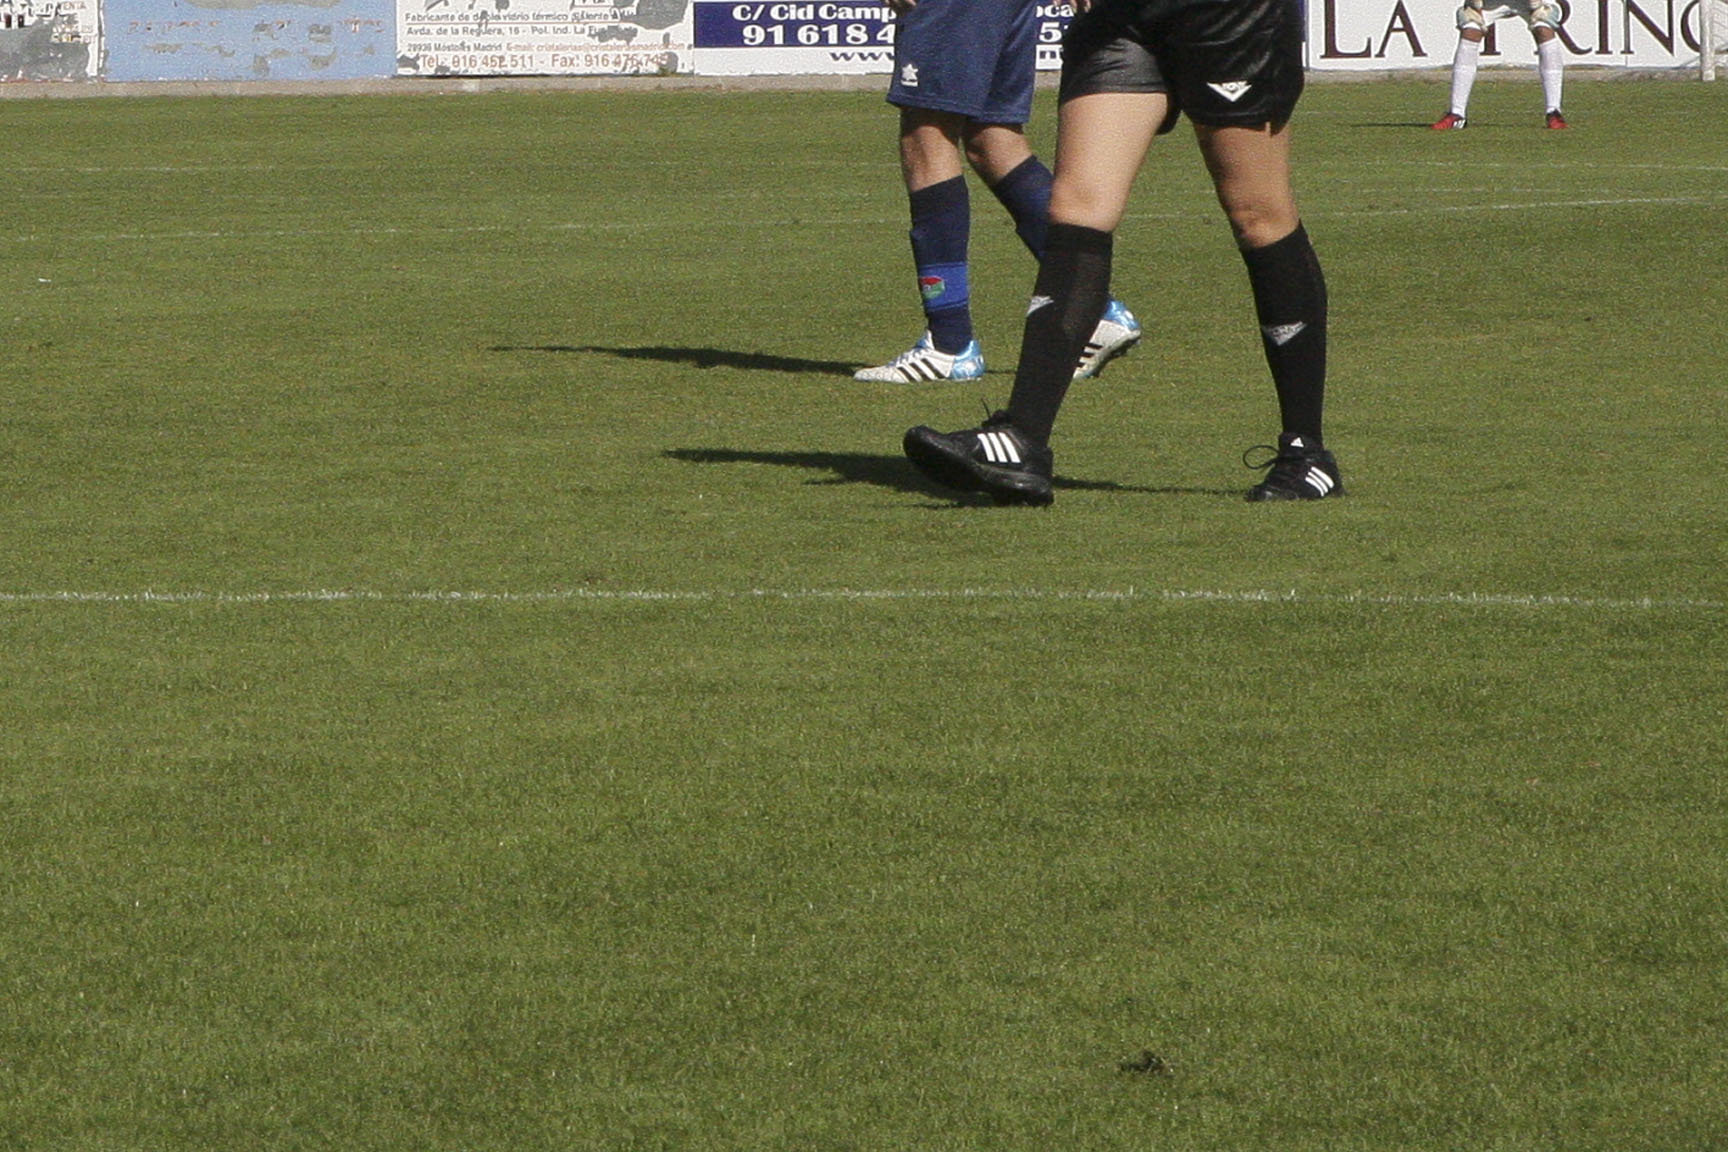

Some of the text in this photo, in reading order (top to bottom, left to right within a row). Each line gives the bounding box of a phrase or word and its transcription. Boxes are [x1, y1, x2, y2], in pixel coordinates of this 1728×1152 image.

[404, 13, 455, 22] Fabricante
[458, 13, 469, 22] de
[503, 12, 529, 21] vidrio
[732, 4, 765, 21] C/
[770, 3, 814, 21] Cid
[407, 27, 433, 36] Avda.
[436, 27, 448, 36] de
[451, 27, 459, 35] la
[531, 26, 549, 35] Pol.
[553, 26, 571, 35] Ind.
[574, 26, 585, 35] La
[742, 24, 785, 45] 91
[797, 23, 868, 45] 618
[474, 43, 502, 52] Madrid
[511, 54, 534, 68] 511
[552, 54, 580, 67] Fax:
[584, 54, 609, 67] 916
